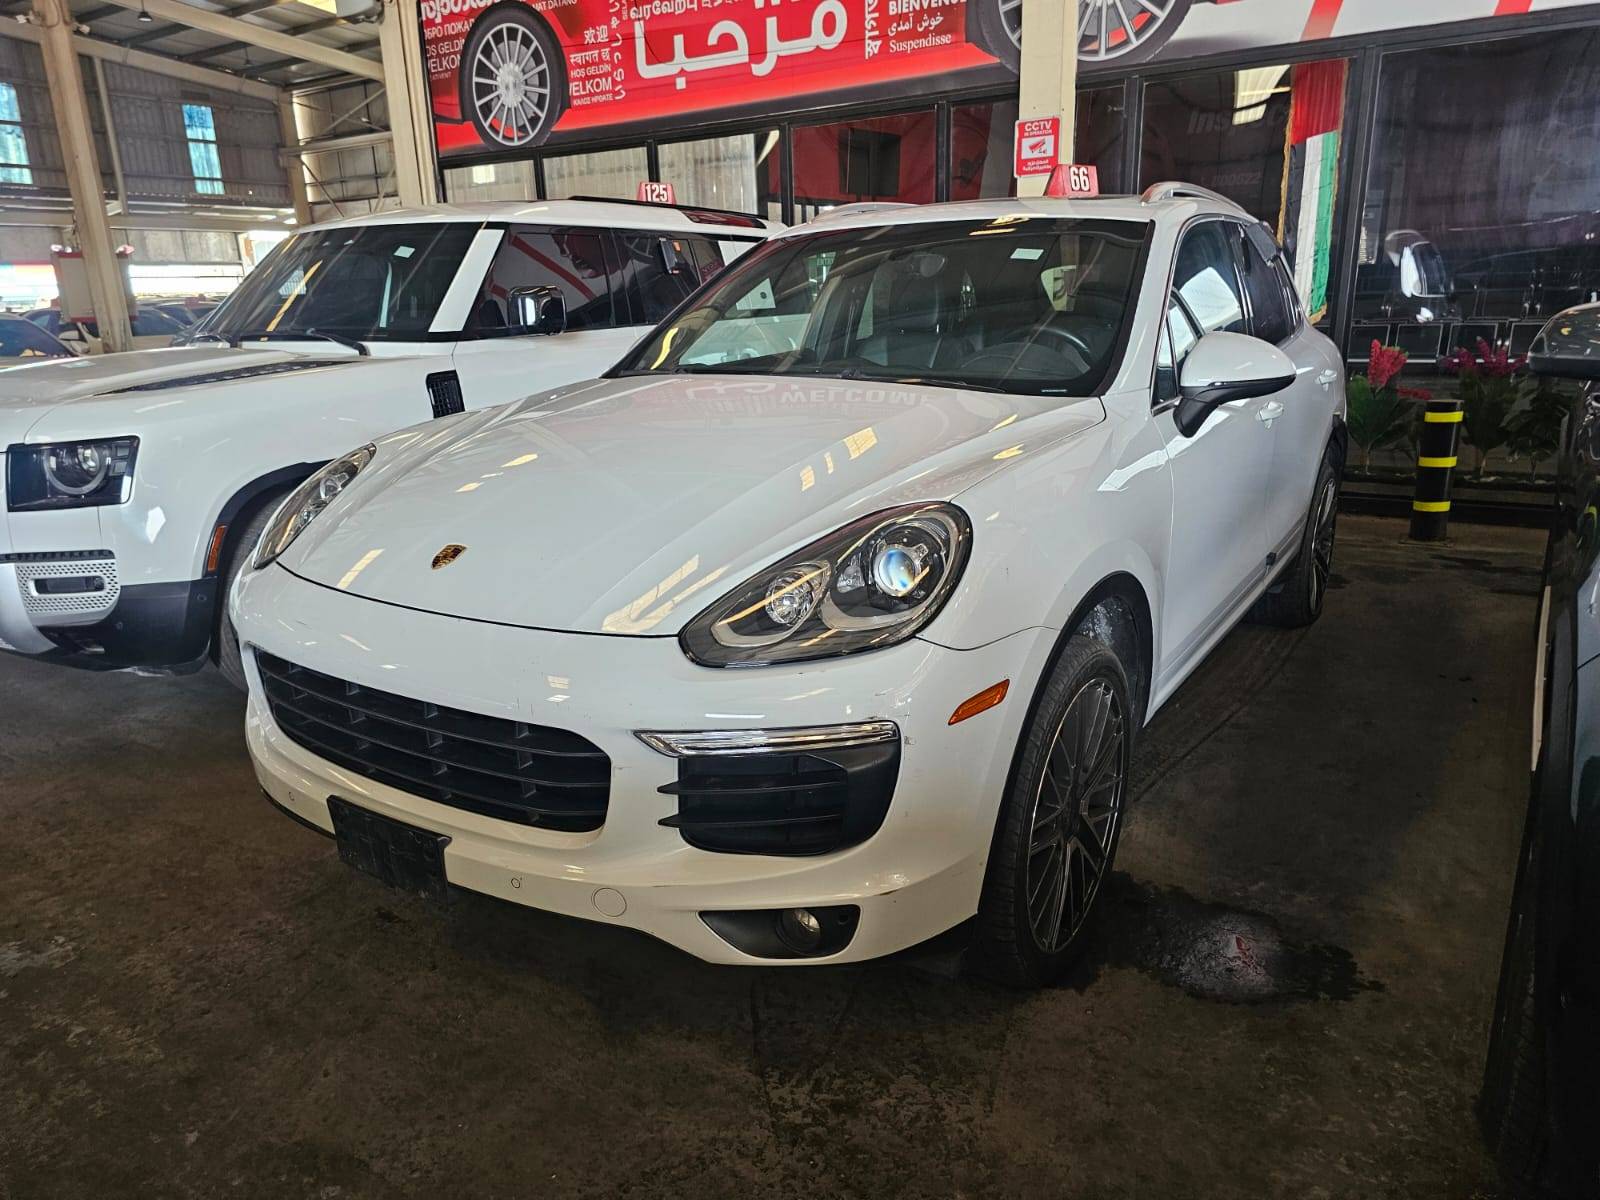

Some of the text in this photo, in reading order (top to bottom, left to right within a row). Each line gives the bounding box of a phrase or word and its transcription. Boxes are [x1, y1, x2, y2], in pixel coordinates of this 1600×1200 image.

[584, 25, 609, 45] 欢迎
[633, 0, 848, 90] مرحبا
[889, 33, 952, 53] Suspendisse
[427, 54, 461, 73] ELKO
[1024, 120, 1052, 132] CCTV
[1069, 166, 1090, 191] 66
[645, 184, 668, 202] 125
